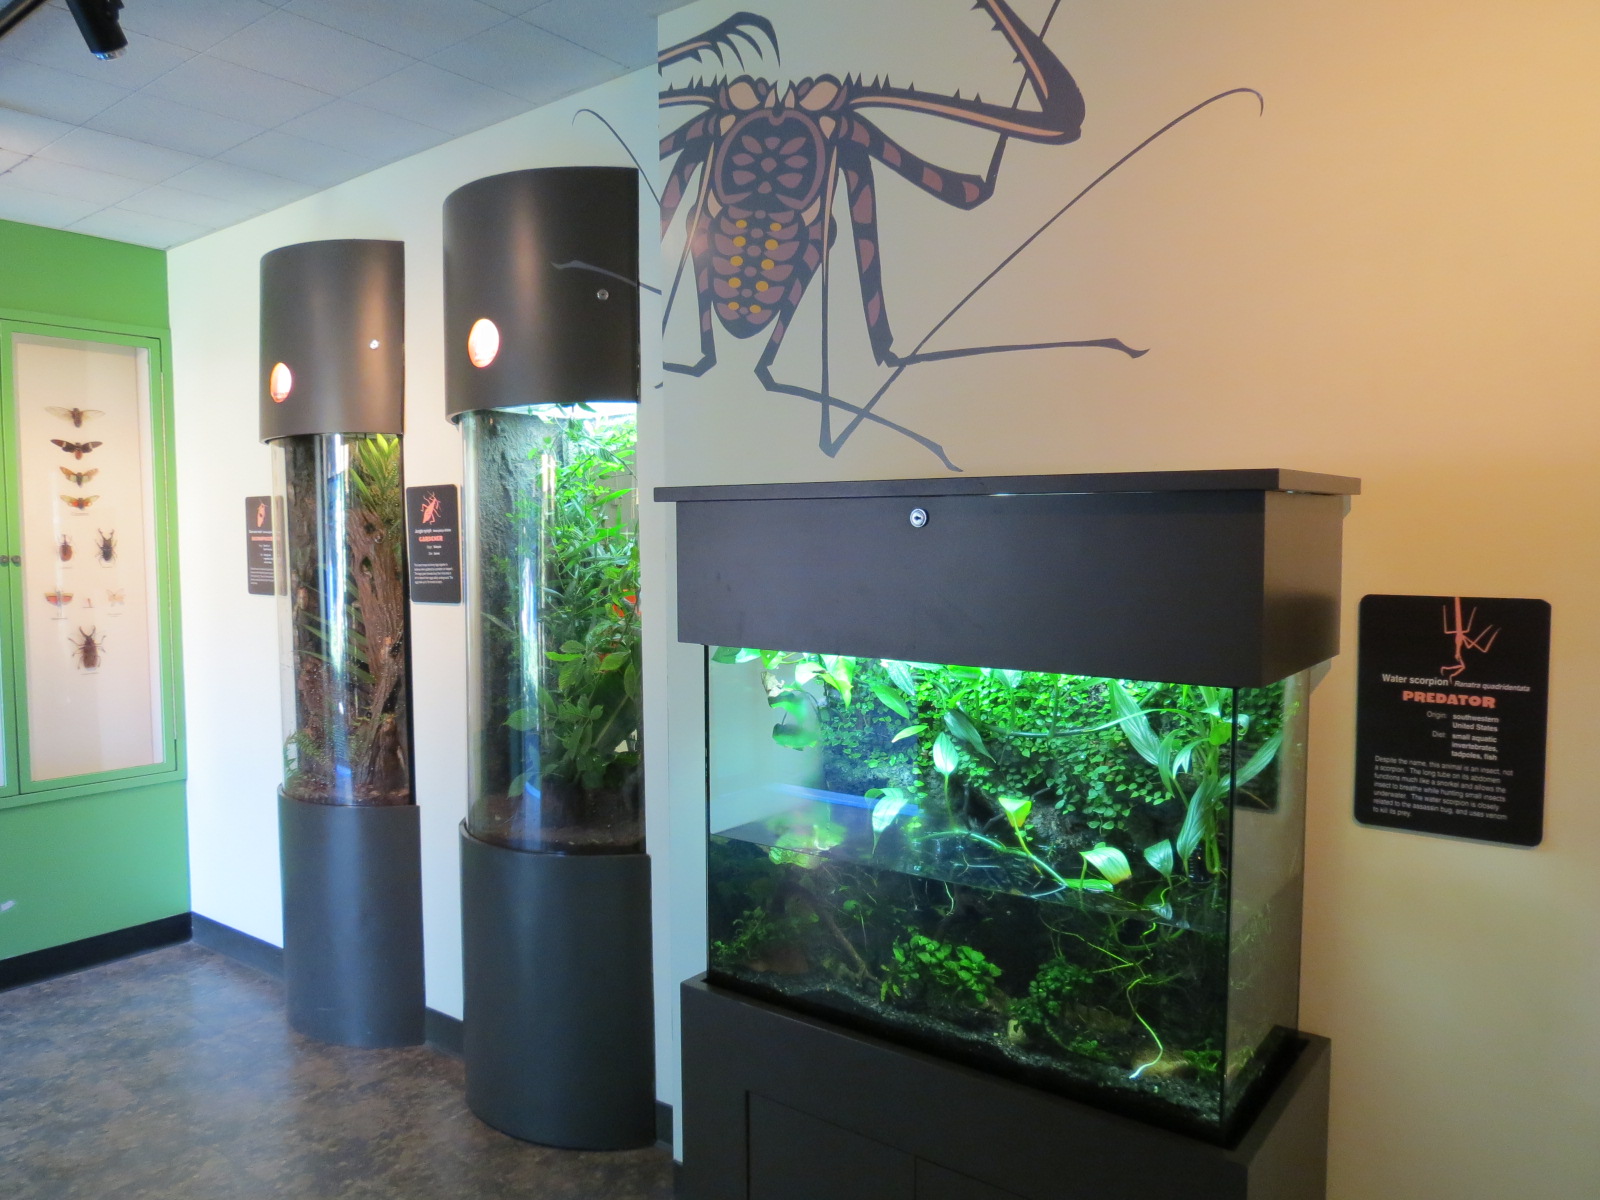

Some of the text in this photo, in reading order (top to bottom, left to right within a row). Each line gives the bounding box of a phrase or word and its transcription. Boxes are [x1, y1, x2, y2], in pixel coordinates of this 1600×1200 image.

[1381, 673, 1531, 692] Water scorpion Ranatra quadridentata
[1402, 690, 1496, 708] PREDATOR
[1452, 713, 1499, 723] southwestern
[1452, 721, 1498, 732] United States
[1452, 733, 1471, 741] small
[1471, 735, 1498, 744] aquatic
[1451, 741, 1499, 752] invertebrates,
[1374, 755, 1397, 763] Despite
[1451, 750, 1498, 761] tadpoles, fish
[1380, 765, 1406, 773] scorpion.
[1409, 767, 1421, 775] The
[1422, 769, 1436, 778] long
[1470, 775, 1501, 783] abdomen
[1374, 772, 1400, 781] functions
[1436, 780, 1460, 788] snorkel
[1473, 784, 1495, 792] allows
[1399, 784, 1423, 792] breathe
[1440, 788, 1464, 799] hunting
[1373, 798, 1394, 806] related
[1412, 803, 1440, 811] assassin
[1455, 808, 1468, 816] and
[1485, 812, 1508, 820] venom
[1411, 793, 1423, 801] The
[1442, 798, 1469, 807] scorpion
[1477, 802, 1500, 812] closely
